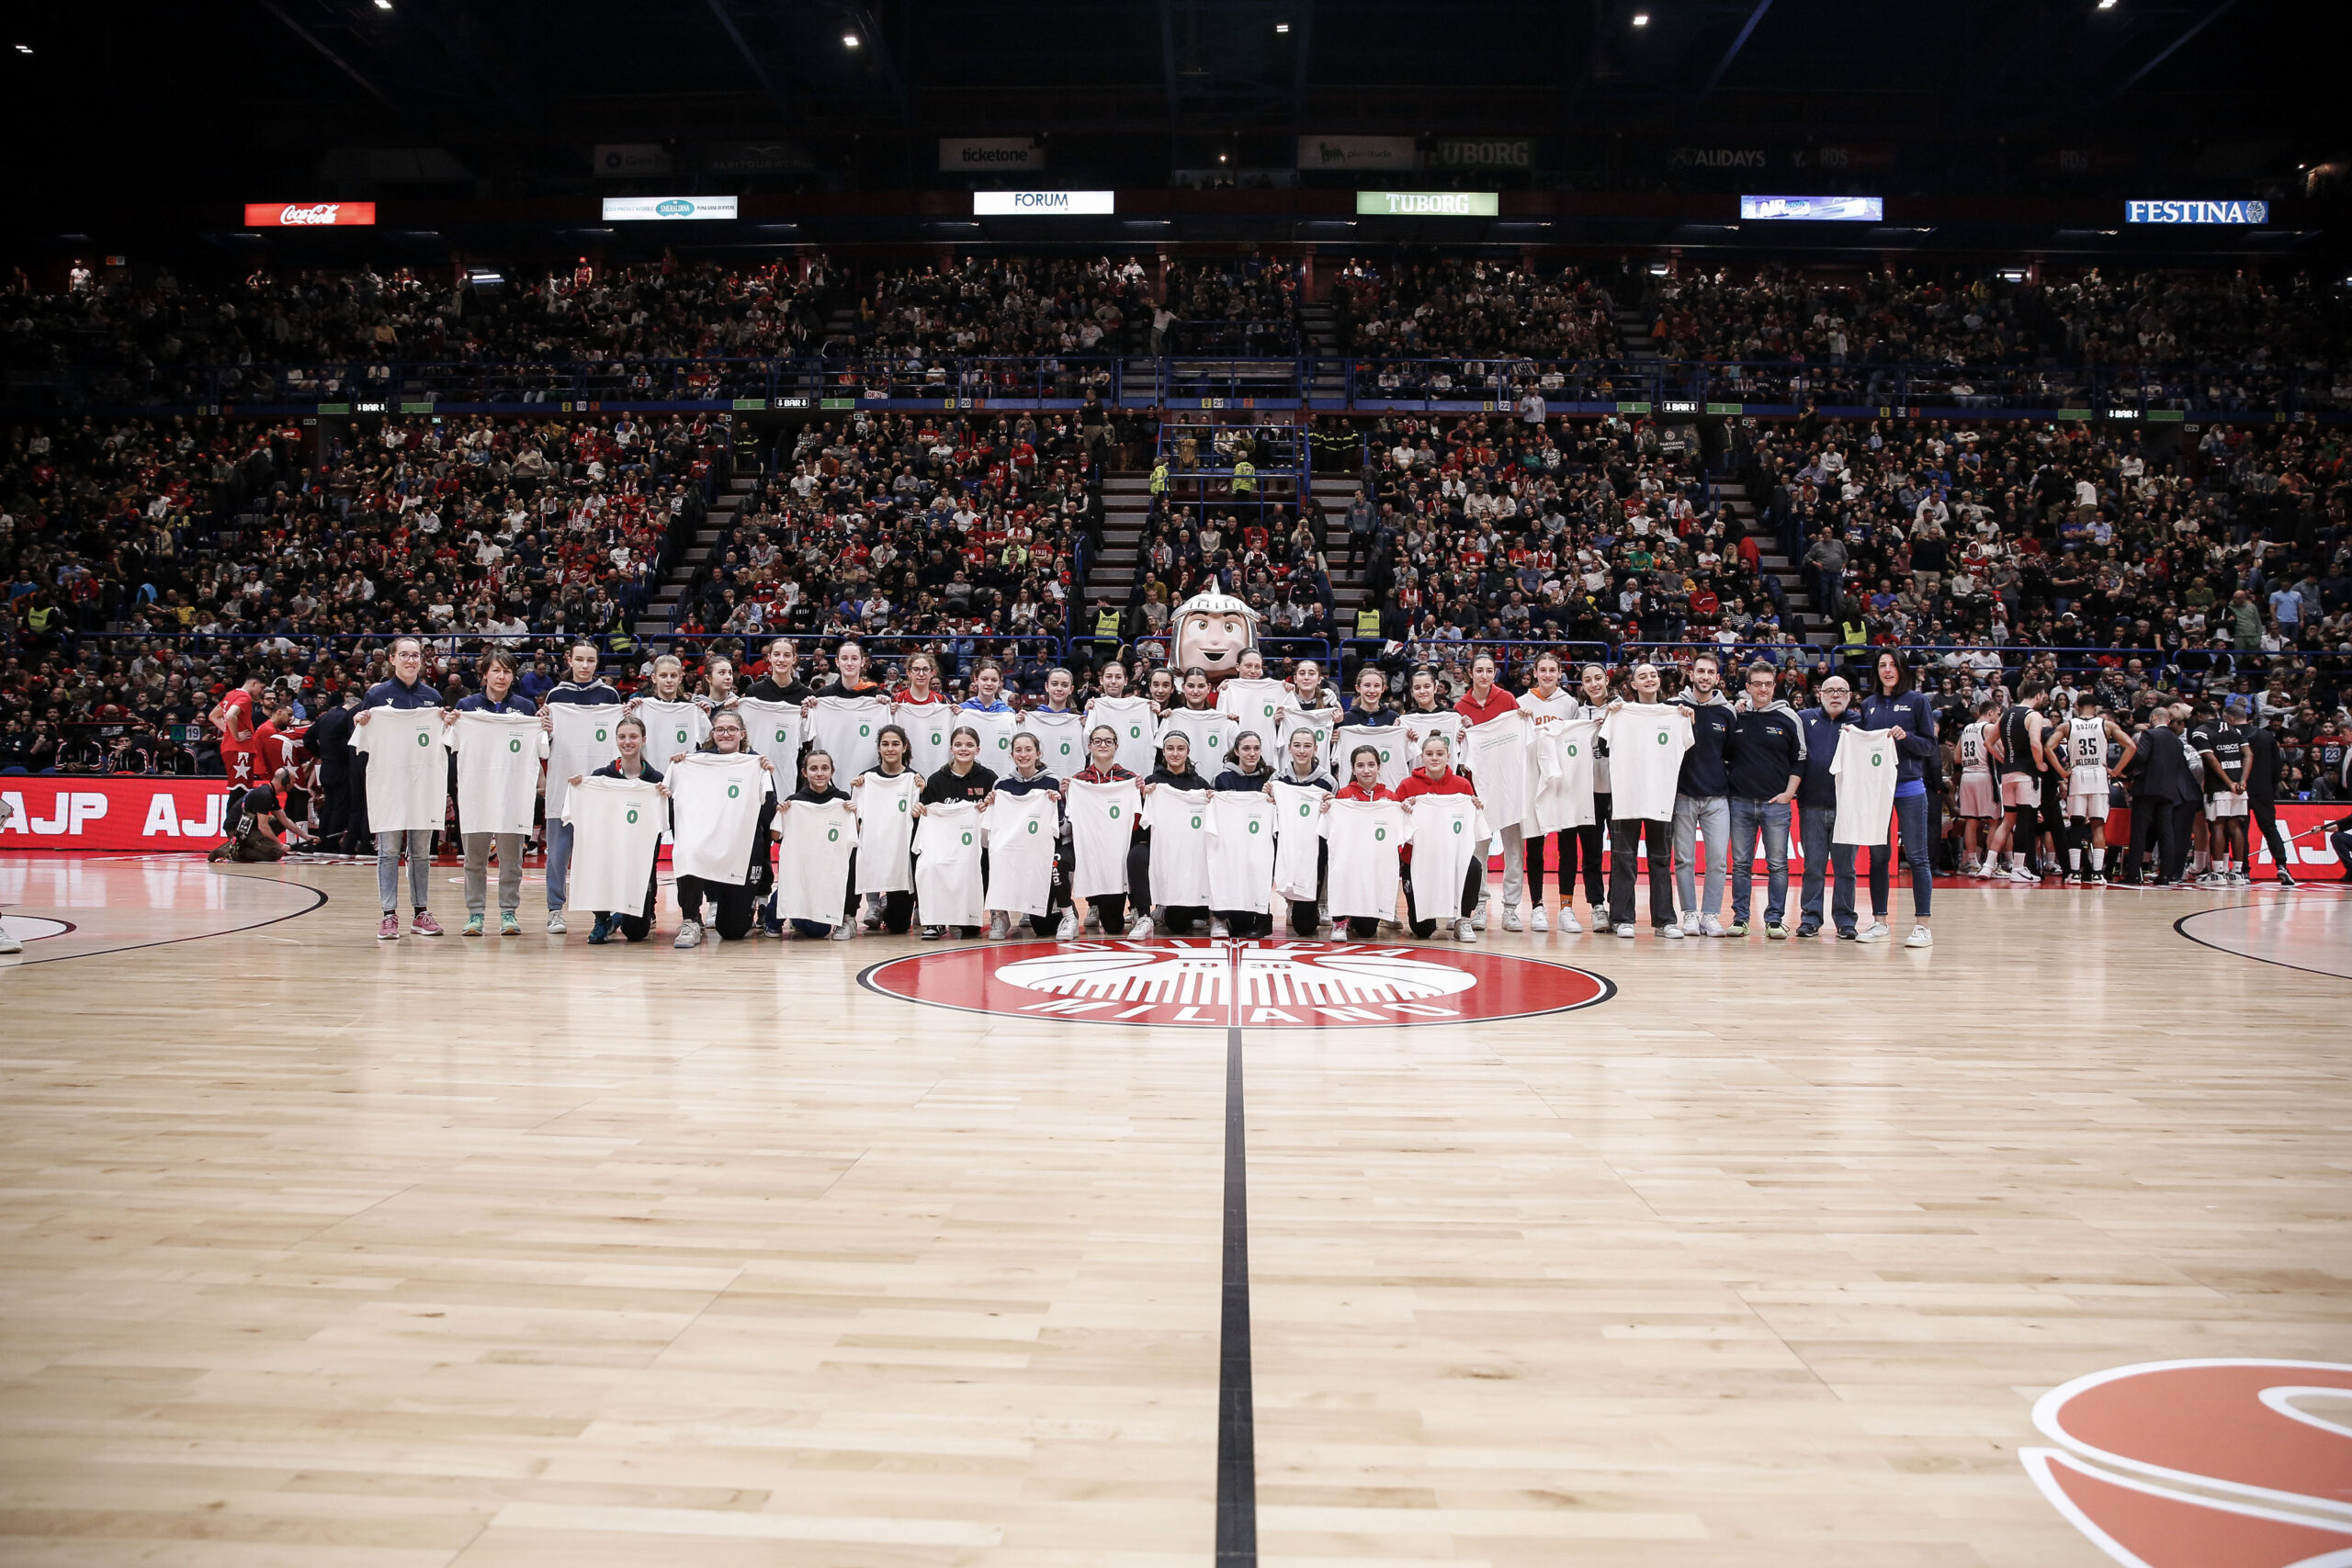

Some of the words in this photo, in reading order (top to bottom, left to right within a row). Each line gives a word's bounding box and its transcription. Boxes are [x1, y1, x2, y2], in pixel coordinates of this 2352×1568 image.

[962, 148, 1027, 162] ticketone
[1347, 149, 1392, 160] plenitude
[1694, 149, 1766, 167] ALIDAYS
[1015, 193, 1069, 207] FORUM
[1385, 194, 1469, 213] TUBORG
[280, 204, 340, 224] Coca-Cola
[2129, 201, 2245, 223] FESTINA
[363, 403, 379, 412] BAR
[1672, 403, 1690, 412] BAR
[2115, 410, 2132, 418] BAR
[1264, 705, 1274, 717] 0
[187, 726, 199, 738] 19
[595, 728, 606, 742] 0
[676, 730, 687, 743] 0
[776, 730, 786, 743] 0
[859, 724, 870, 738] 0
[1130, 727, 1140, 739] 0
[1316, 729, 1326, 742] 0
[418, 733, 429, 747] 0
[932, 733, 942, 745] 0
[999, 737, 1008, 750] 0
[1208, 735, 1218, 749] 0
[1658, 732, 1668, 745] 0
[509, 739, 520, 752] 0
[1059, 743, 1070, 756] 0
[1567, 744, 1577, 757] 0
[1963, 740, 1975, 758] 33
[2078, 738, 2098, 756] 35
[1381, 750, 1390, 762] 0
[1872, 754, 1883, 766] 0
[2325, 749, 2340, 761] 23
[728, 784, 740, 799] 0
[898, 799, 907, 812] 0
[1109, 806, 1120, 818] 0
[1300, 804, 1311, 817] 0
[0, 791, 108, 835] AJP
[627, 809, 639, 824] 0
[1028, 821, 1038, 834] 0
[1191, 816, 1202, 829] 0
[1249, 821, 1260, 834] 0
[1453, 821, 1463, 834] 0
[828, 829, 839, 842] 0
[962, 832, 972, 846] 0
[1375, 828, 1385, 840] 0
[1057, 940, 1415, 958] OLIMPIA
[1019, 998, 1461, 1023] MILANO
